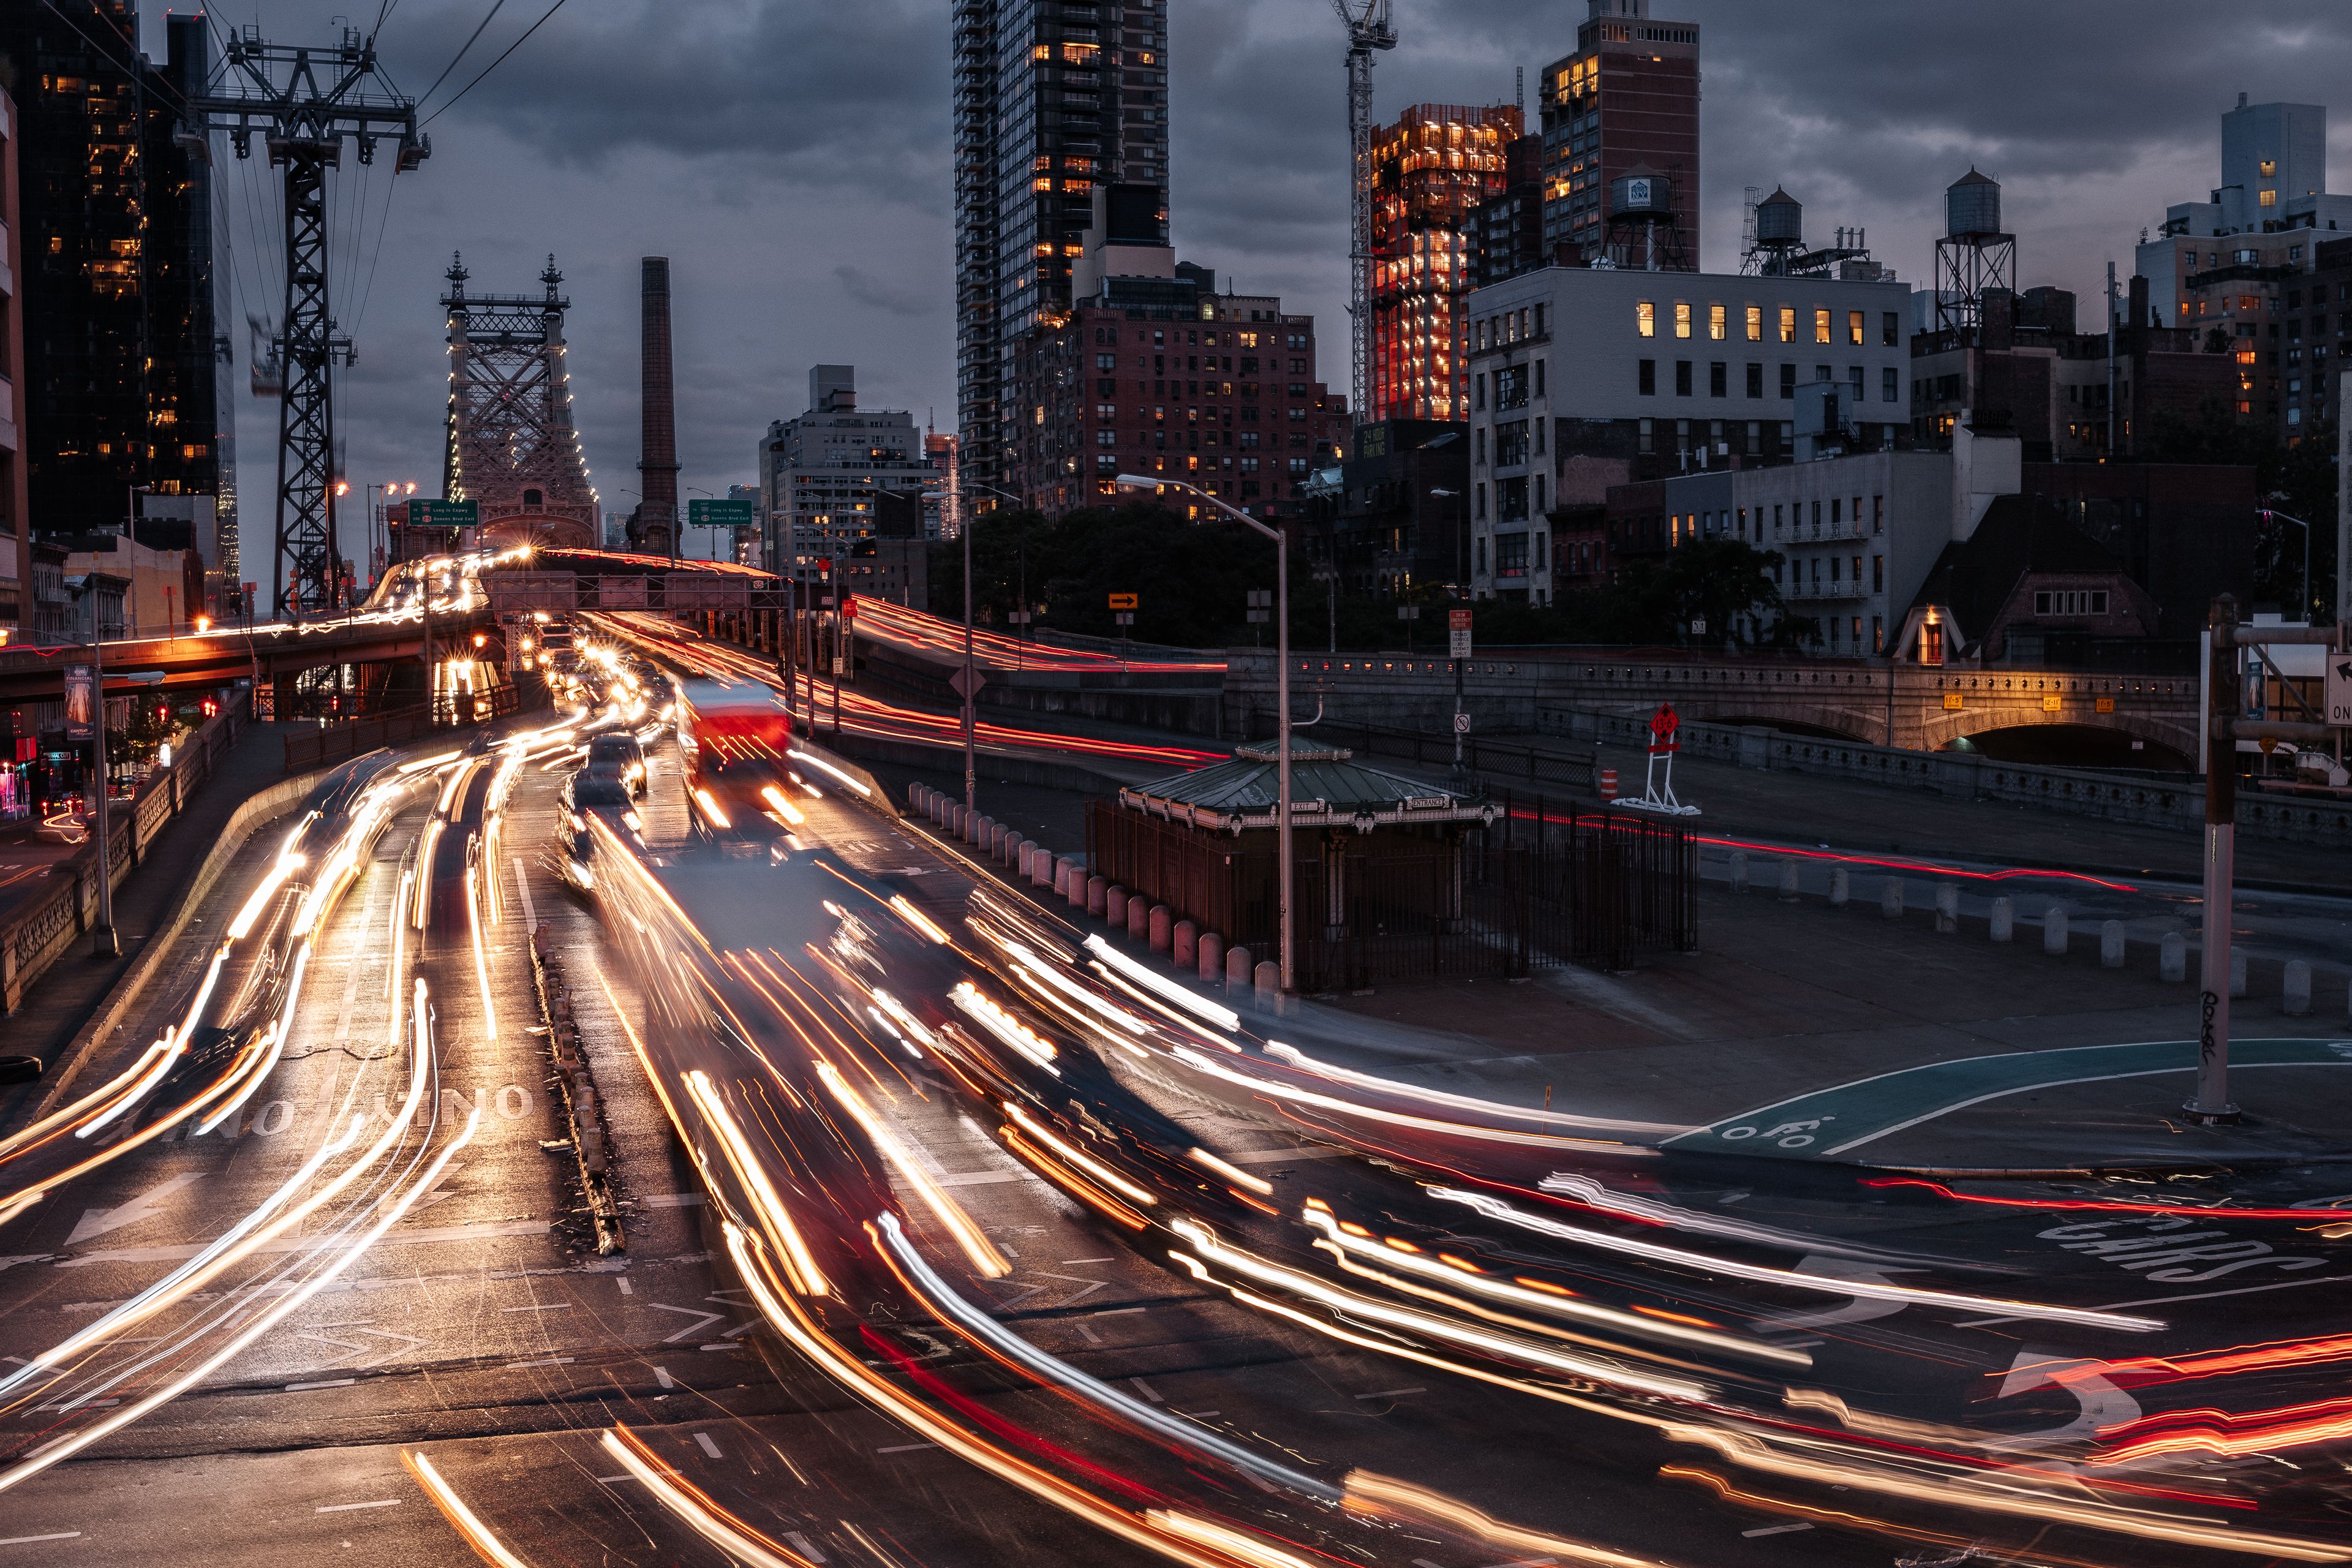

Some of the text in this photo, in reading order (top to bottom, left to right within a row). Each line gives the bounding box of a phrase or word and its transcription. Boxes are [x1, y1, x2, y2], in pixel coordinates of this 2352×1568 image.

[1363, 427, 1385, 443] 24 HOUR
[1363, 441, 1385, 459] PARKING
[2034, 1217, 2329, 1283] CARS
